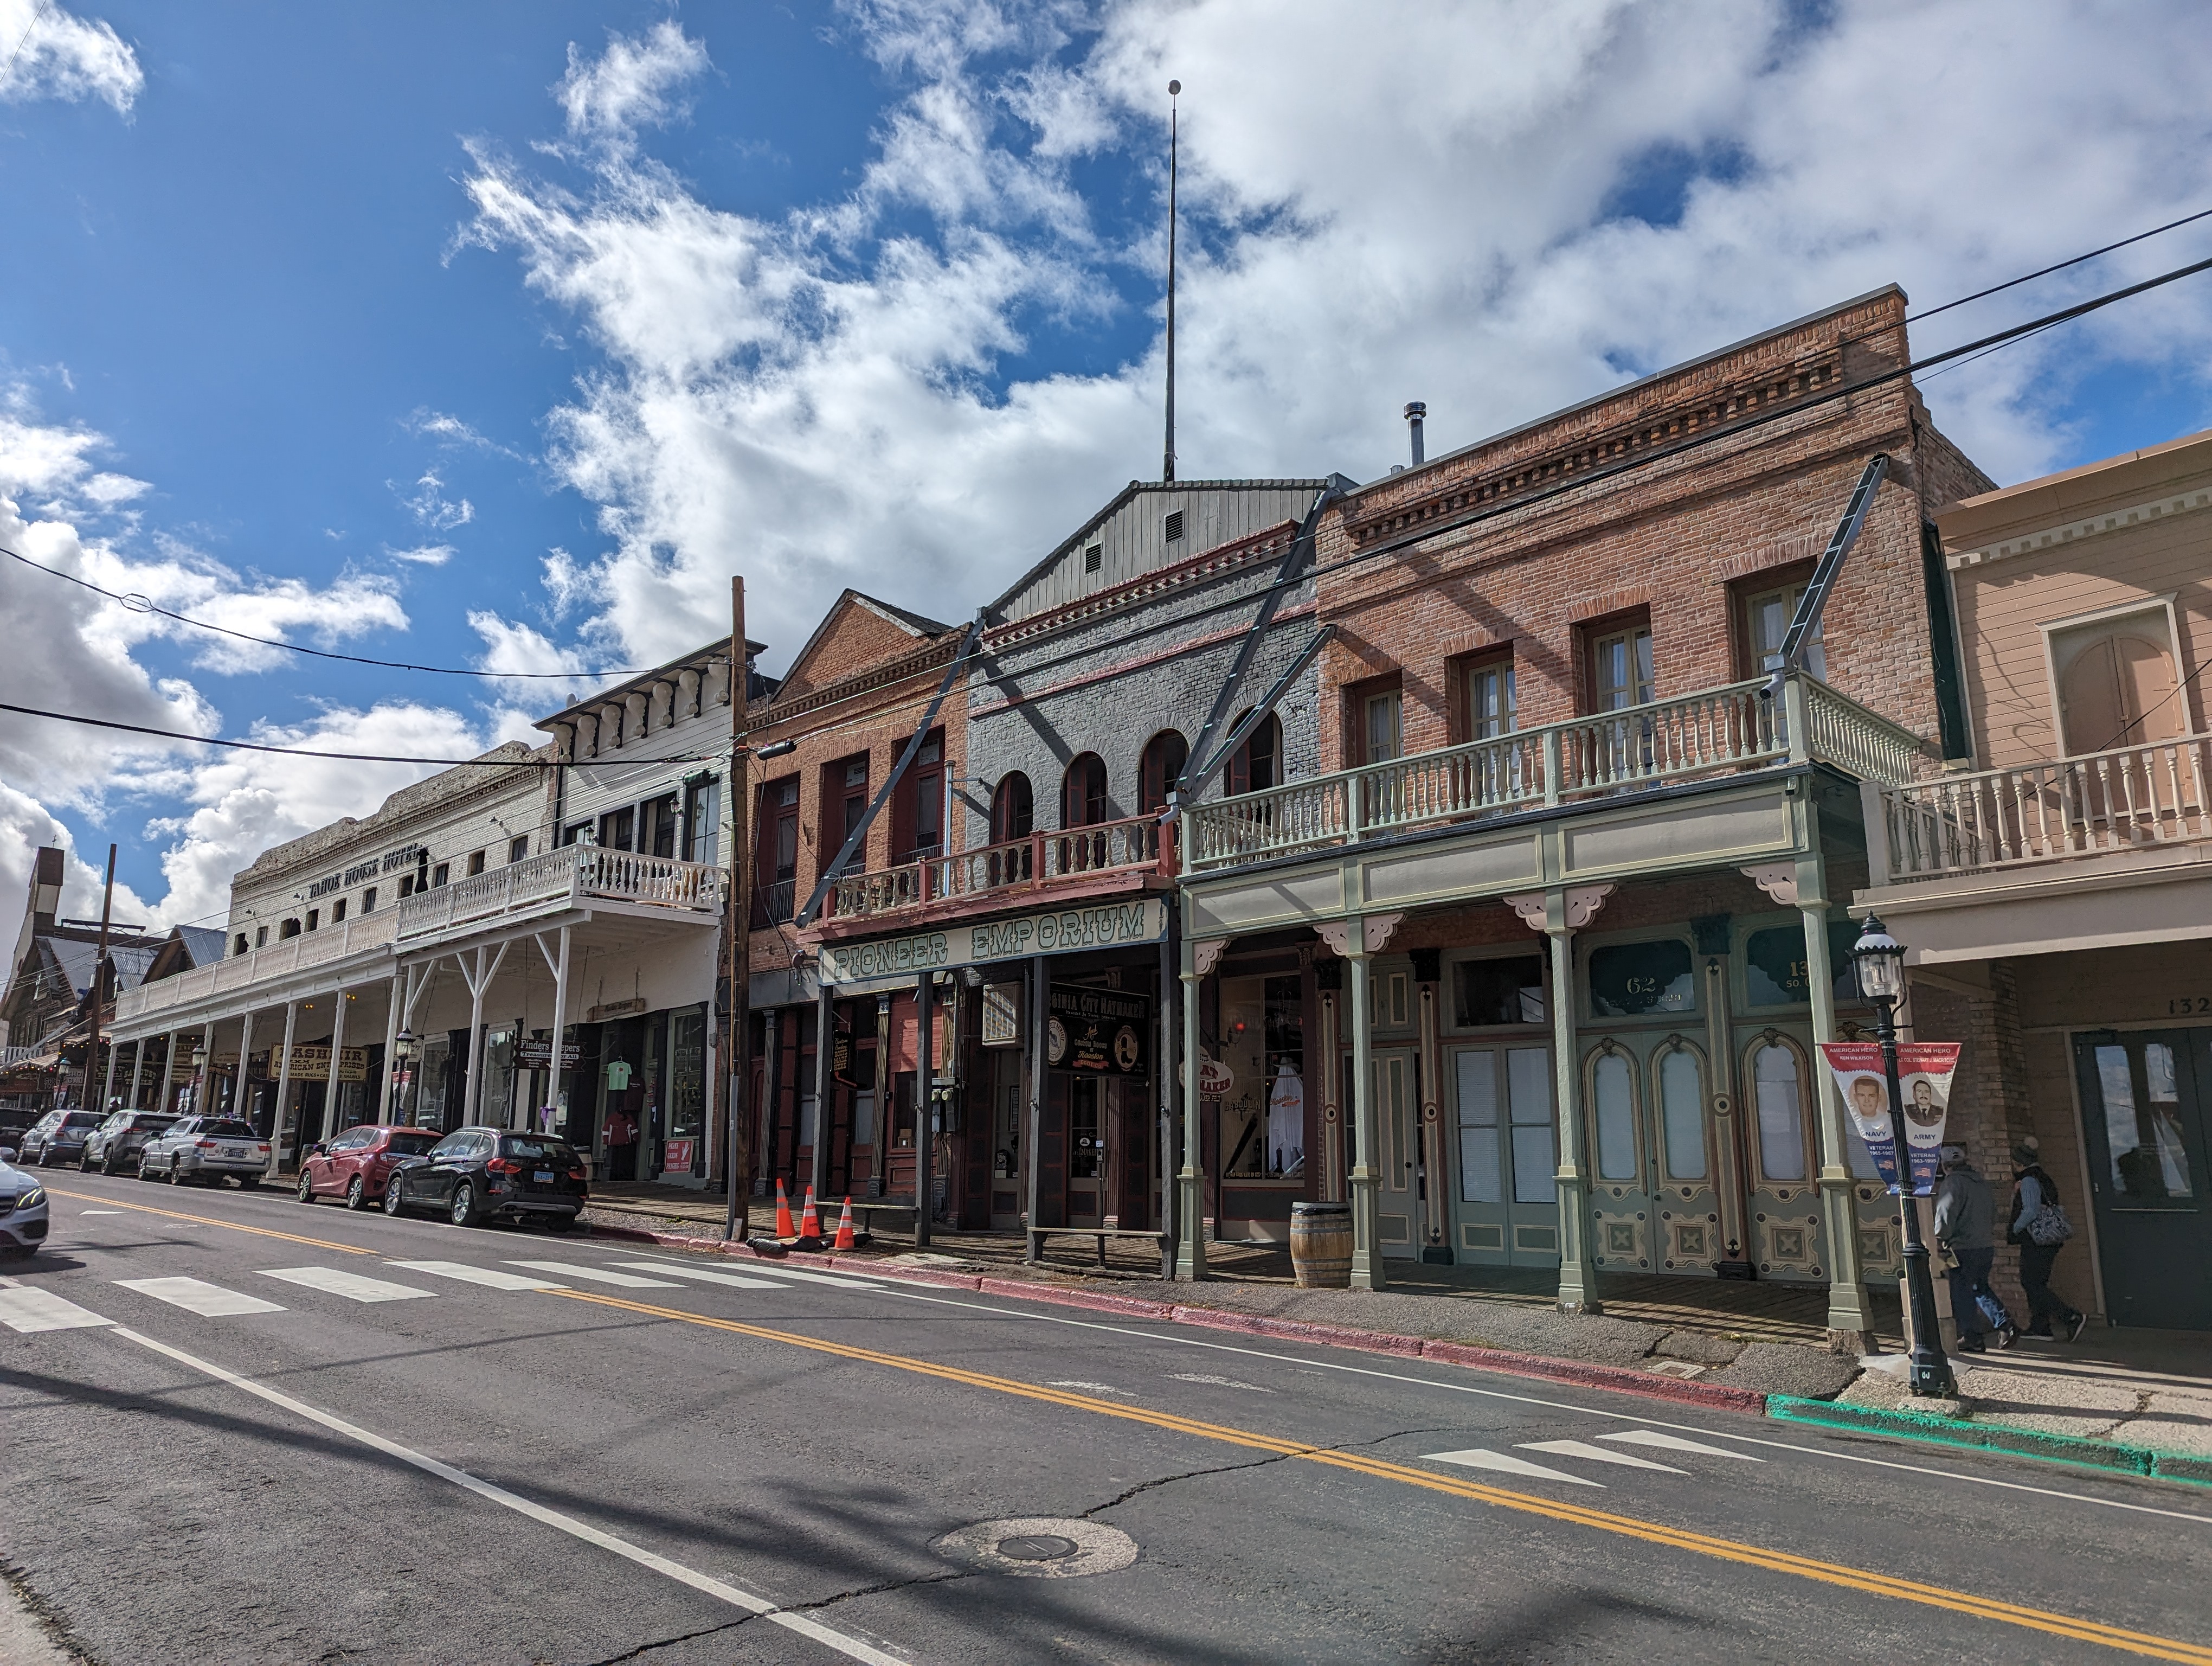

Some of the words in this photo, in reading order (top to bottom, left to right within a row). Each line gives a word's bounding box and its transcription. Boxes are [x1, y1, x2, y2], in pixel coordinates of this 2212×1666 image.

[308, 873, 341, 898] TAHOE
[344, 858, 380, 885] HOUSE
[382, 842, 419, 871] HOTEL
[834, 933, 948, 978] PIONEER
[972, 902, 1145, 960] EMPORIUM
[1791, 960, 1809, 976] 13
[1627, 978, 1655, 994] 62
[1081, 995, 1099, 1013] CITY
[2170, 998, 2209, 1014] 132
[1083, 1024, 1098, 1040] And
[520, 1039, 550, 1050] Finders
[279, 1047, 362, 1061] ASHIR
[1200, 1065, 1218, 1080] AT
